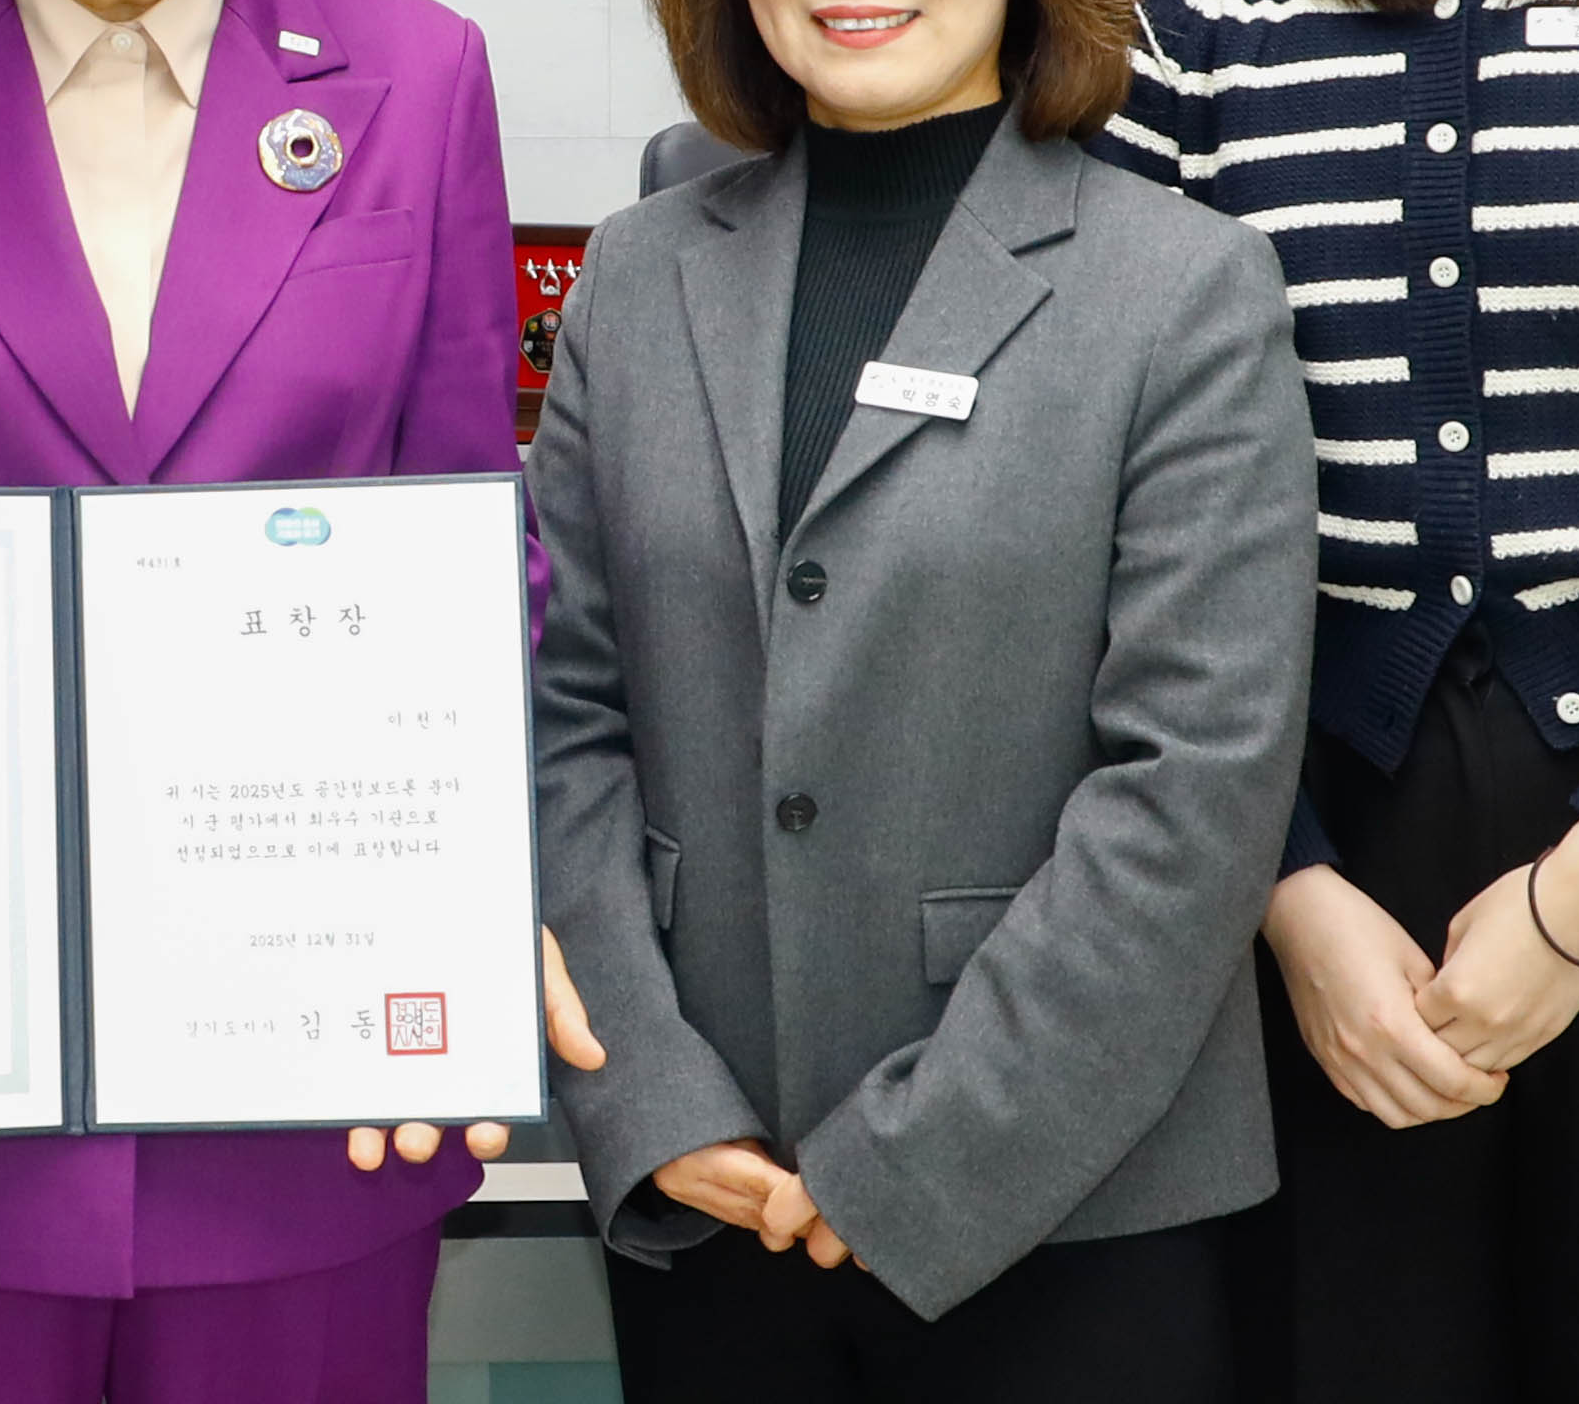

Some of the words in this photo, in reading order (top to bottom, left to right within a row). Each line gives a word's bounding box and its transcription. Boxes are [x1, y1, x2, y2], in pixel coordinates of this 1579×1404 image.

[191, 785, 222, 801] 시는
[229, 783, 306, 801] 2025년도
[308, 809, 362, 829] 최우수
[369, 807, 441, 828] 기관으로
[176, 842, 297, 863] 선정되었으므로
[307, 840, 340, 857] 이에
[249, 931, 297, 948] 2025년
